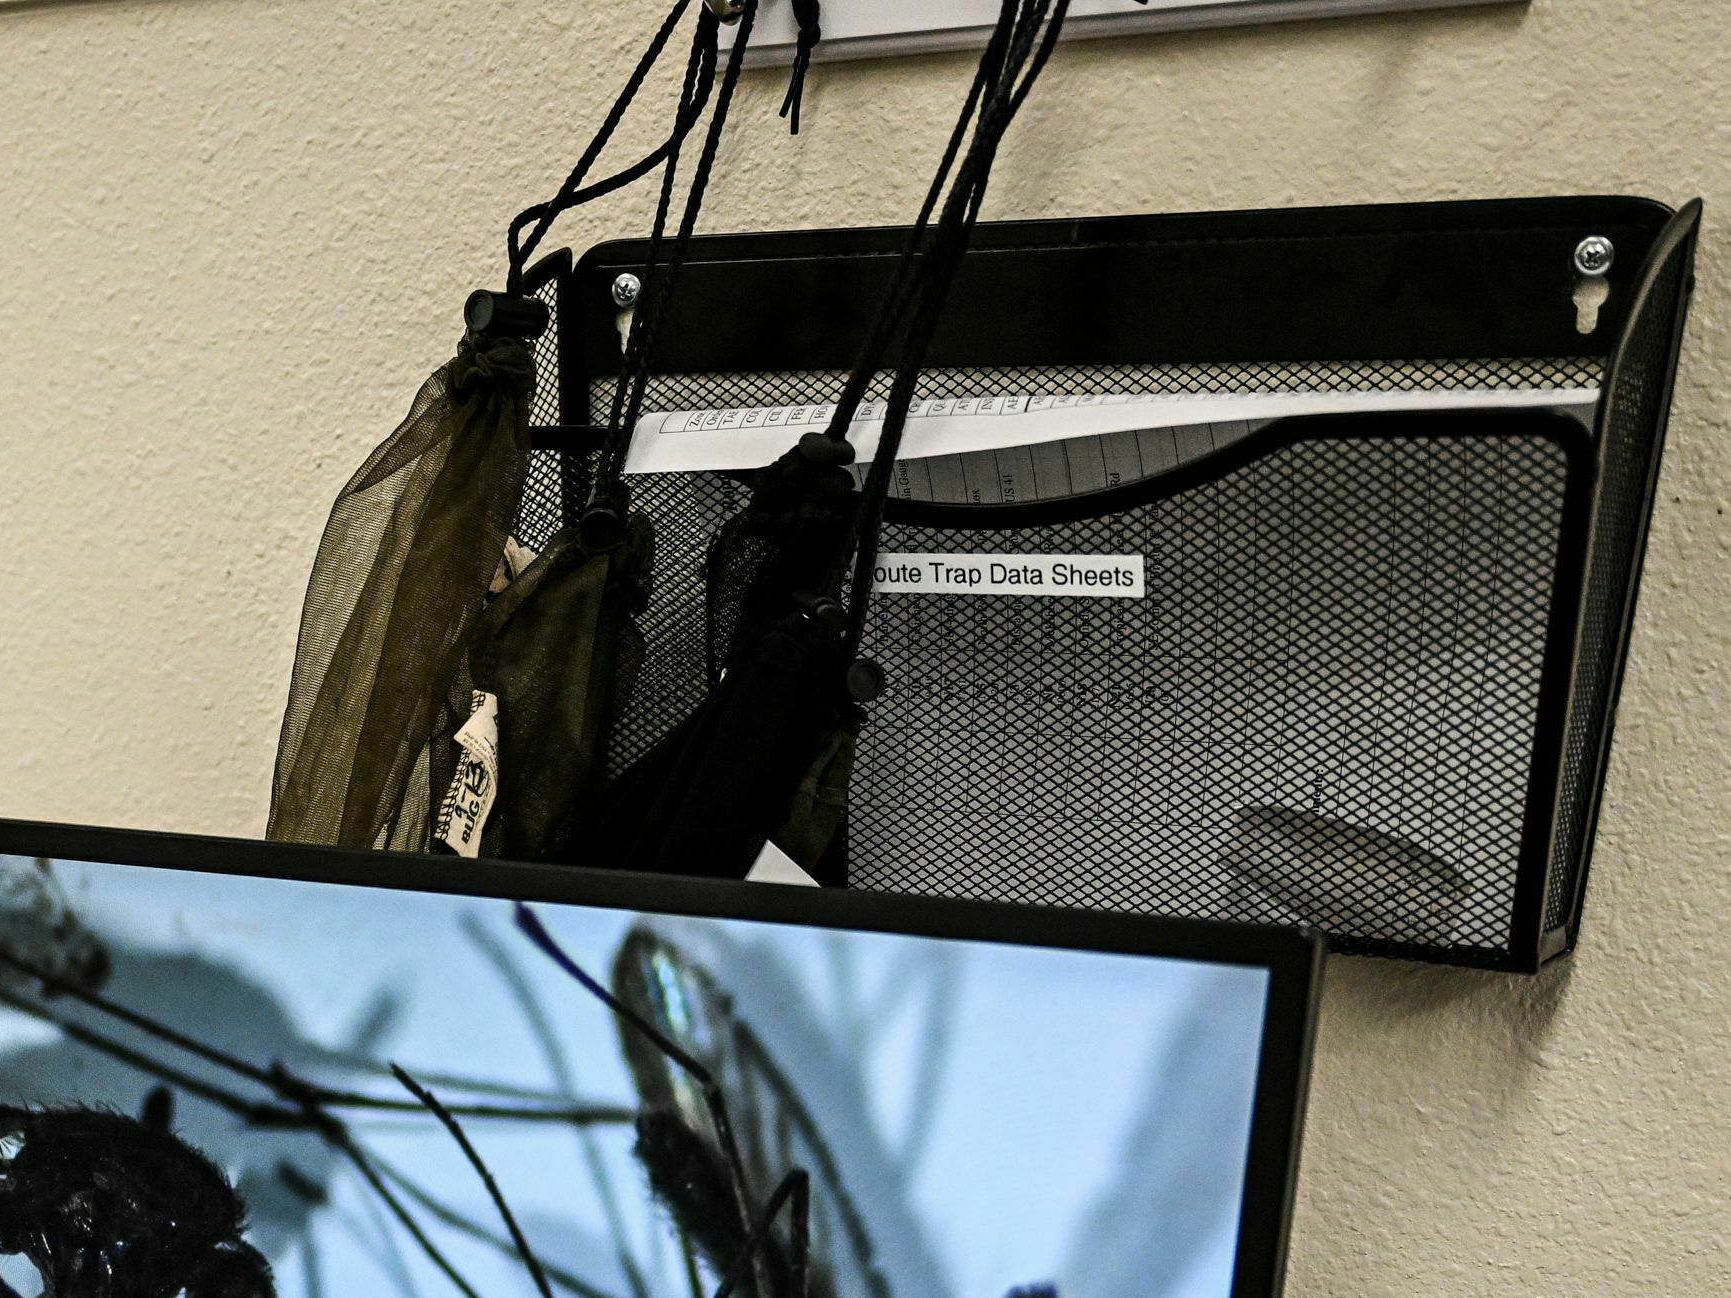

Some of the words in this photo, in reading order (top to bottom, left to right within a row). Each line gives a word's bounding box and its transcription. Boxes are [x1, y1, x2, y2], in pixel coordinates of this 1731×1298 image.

[872, 564, 922, 584] oute
[928, 562, 982, 588] Trap
[990, 563, 1044, 585] Data
[1051, 564, 1135, 587] Sheets
[461, 800, 480, 845] BUG
